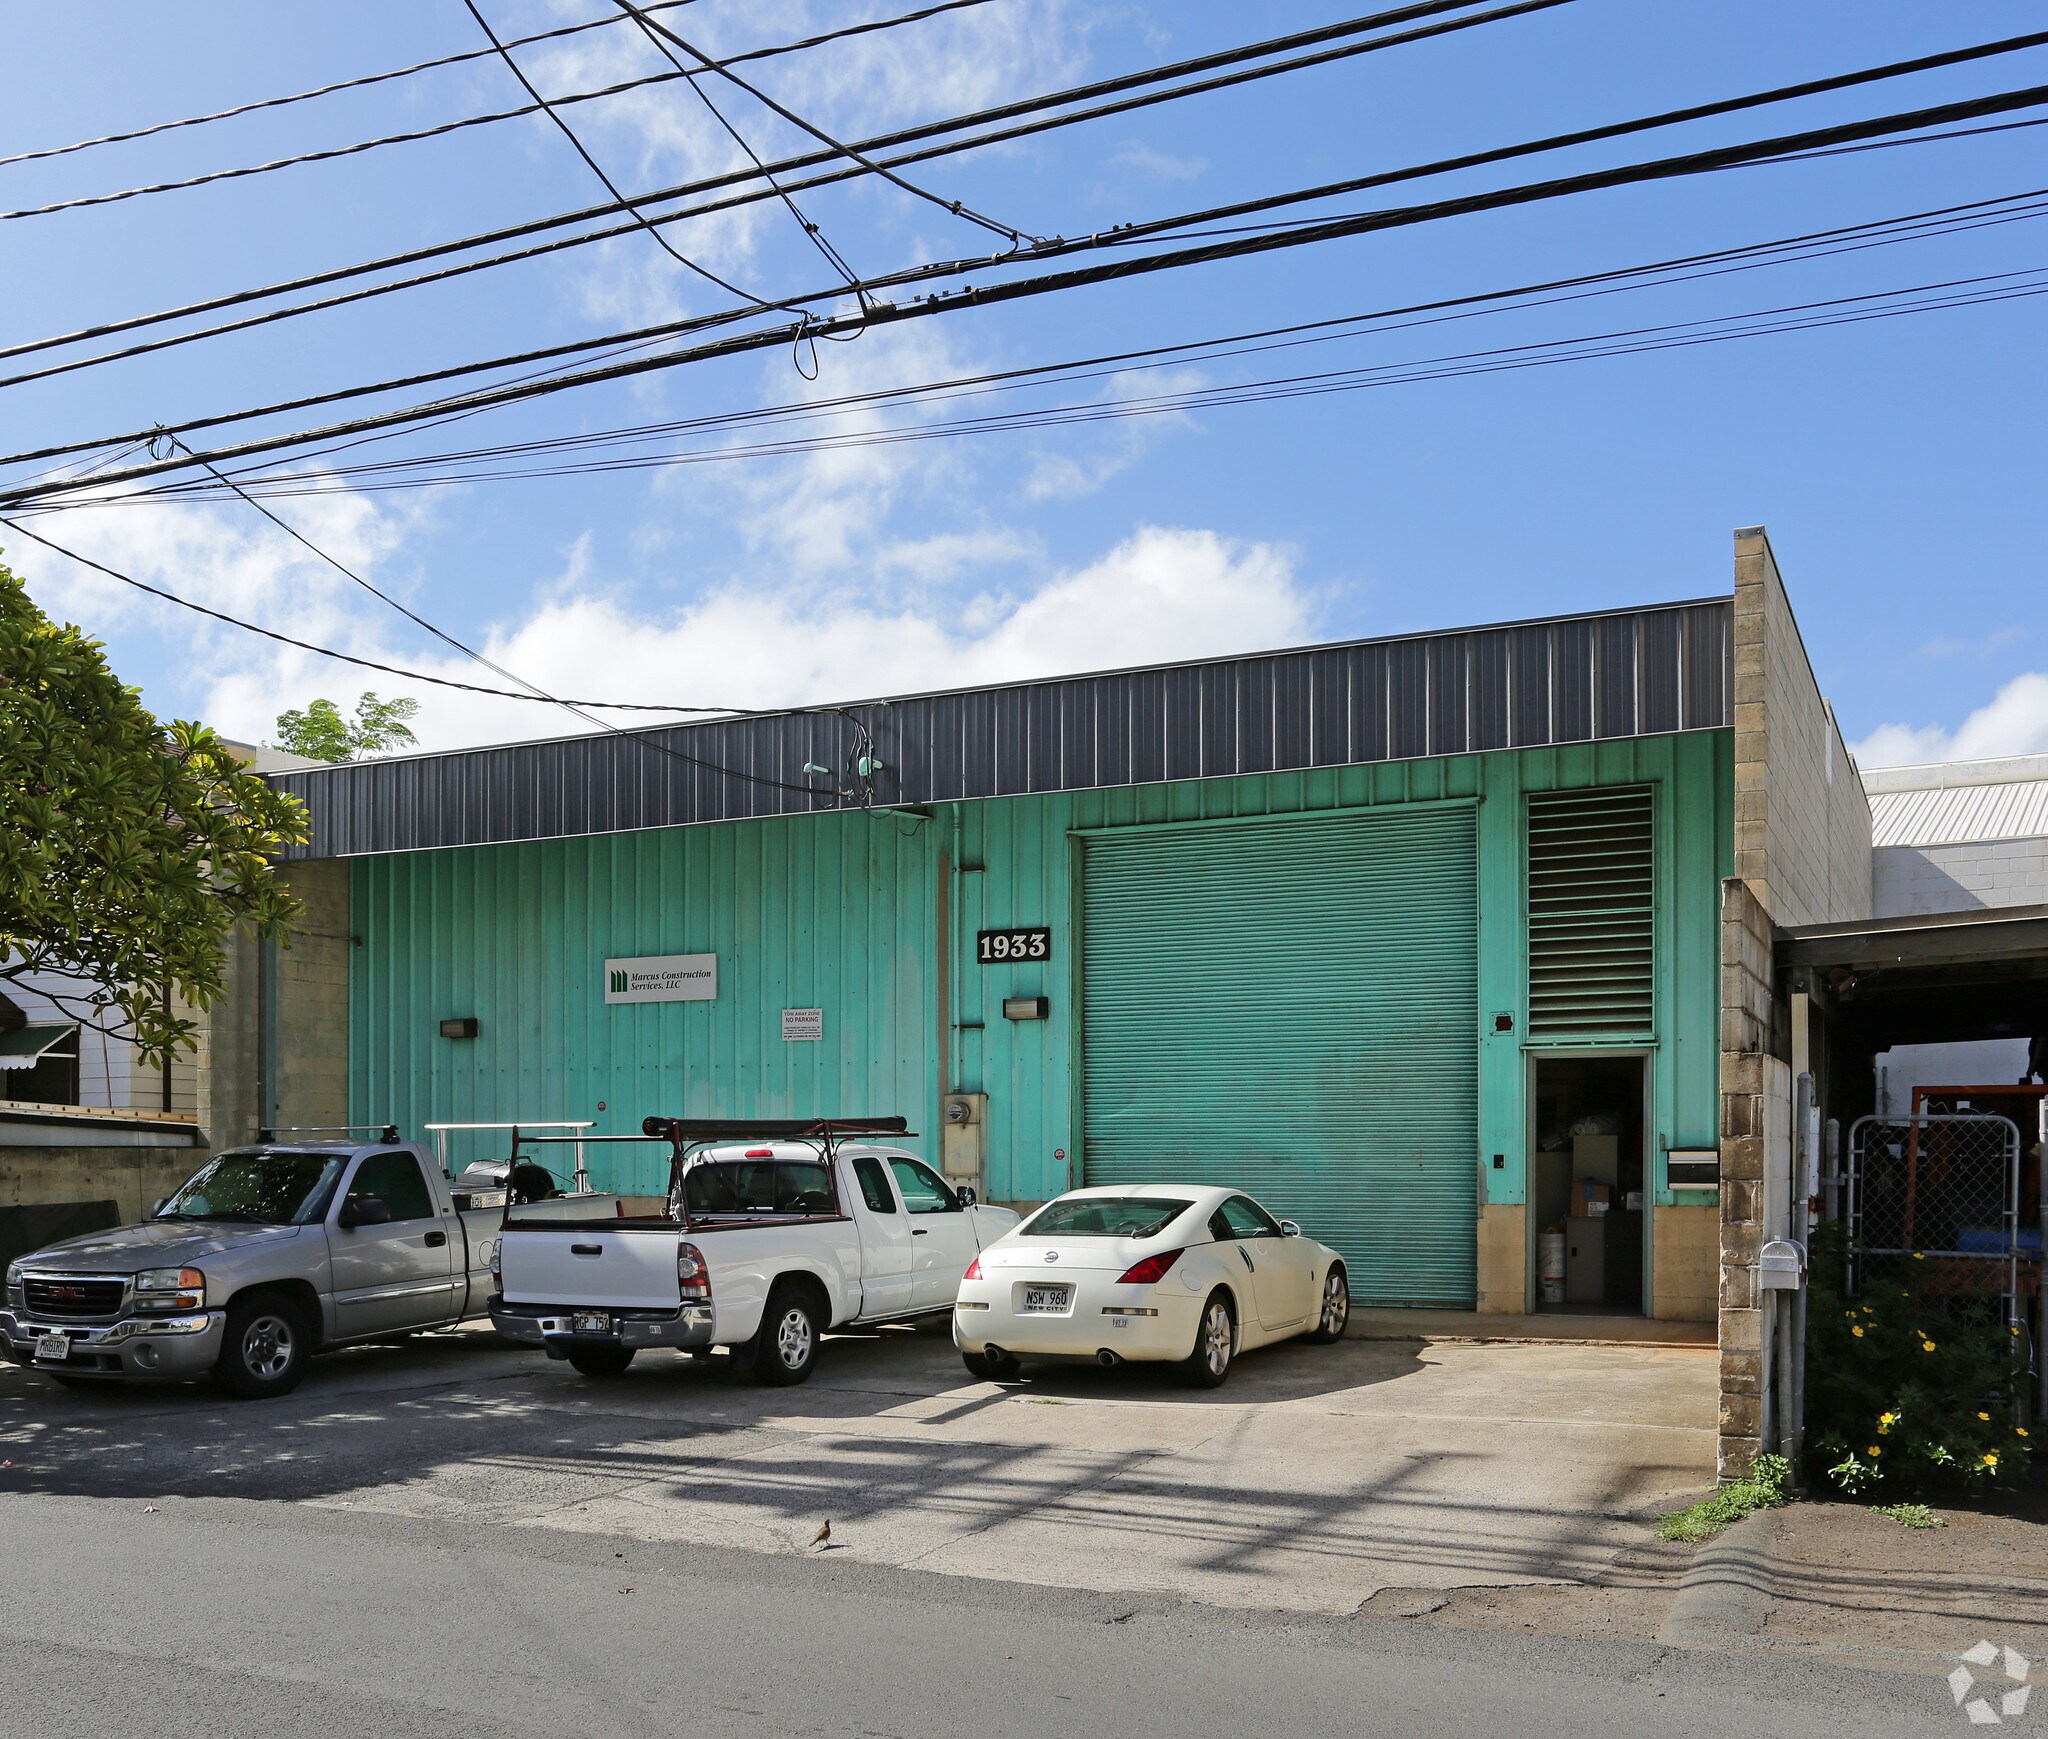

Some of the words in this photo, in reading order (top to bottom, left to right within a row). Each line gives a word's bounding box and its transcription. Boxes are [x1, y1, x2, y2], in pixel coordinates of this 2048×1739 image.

[981, 933, 1045, 958] 1933
[631, 973, 659, 981] Marcus
[661, 969, 711, 980] Construction
[631, 982, 664, 991] Services,
[665, 980, 681, 989] LLC
[48, 1286, 85, 1299] GMC
[1026, 1291, 1045, 1304] NSW
[1050, 1291, 1067, 1305] 960
[574, 1316, 589, 1329] RGP
[594, 1316, 610, 1329] 752
[40, 1339, 66, 1353] MRBIRD
